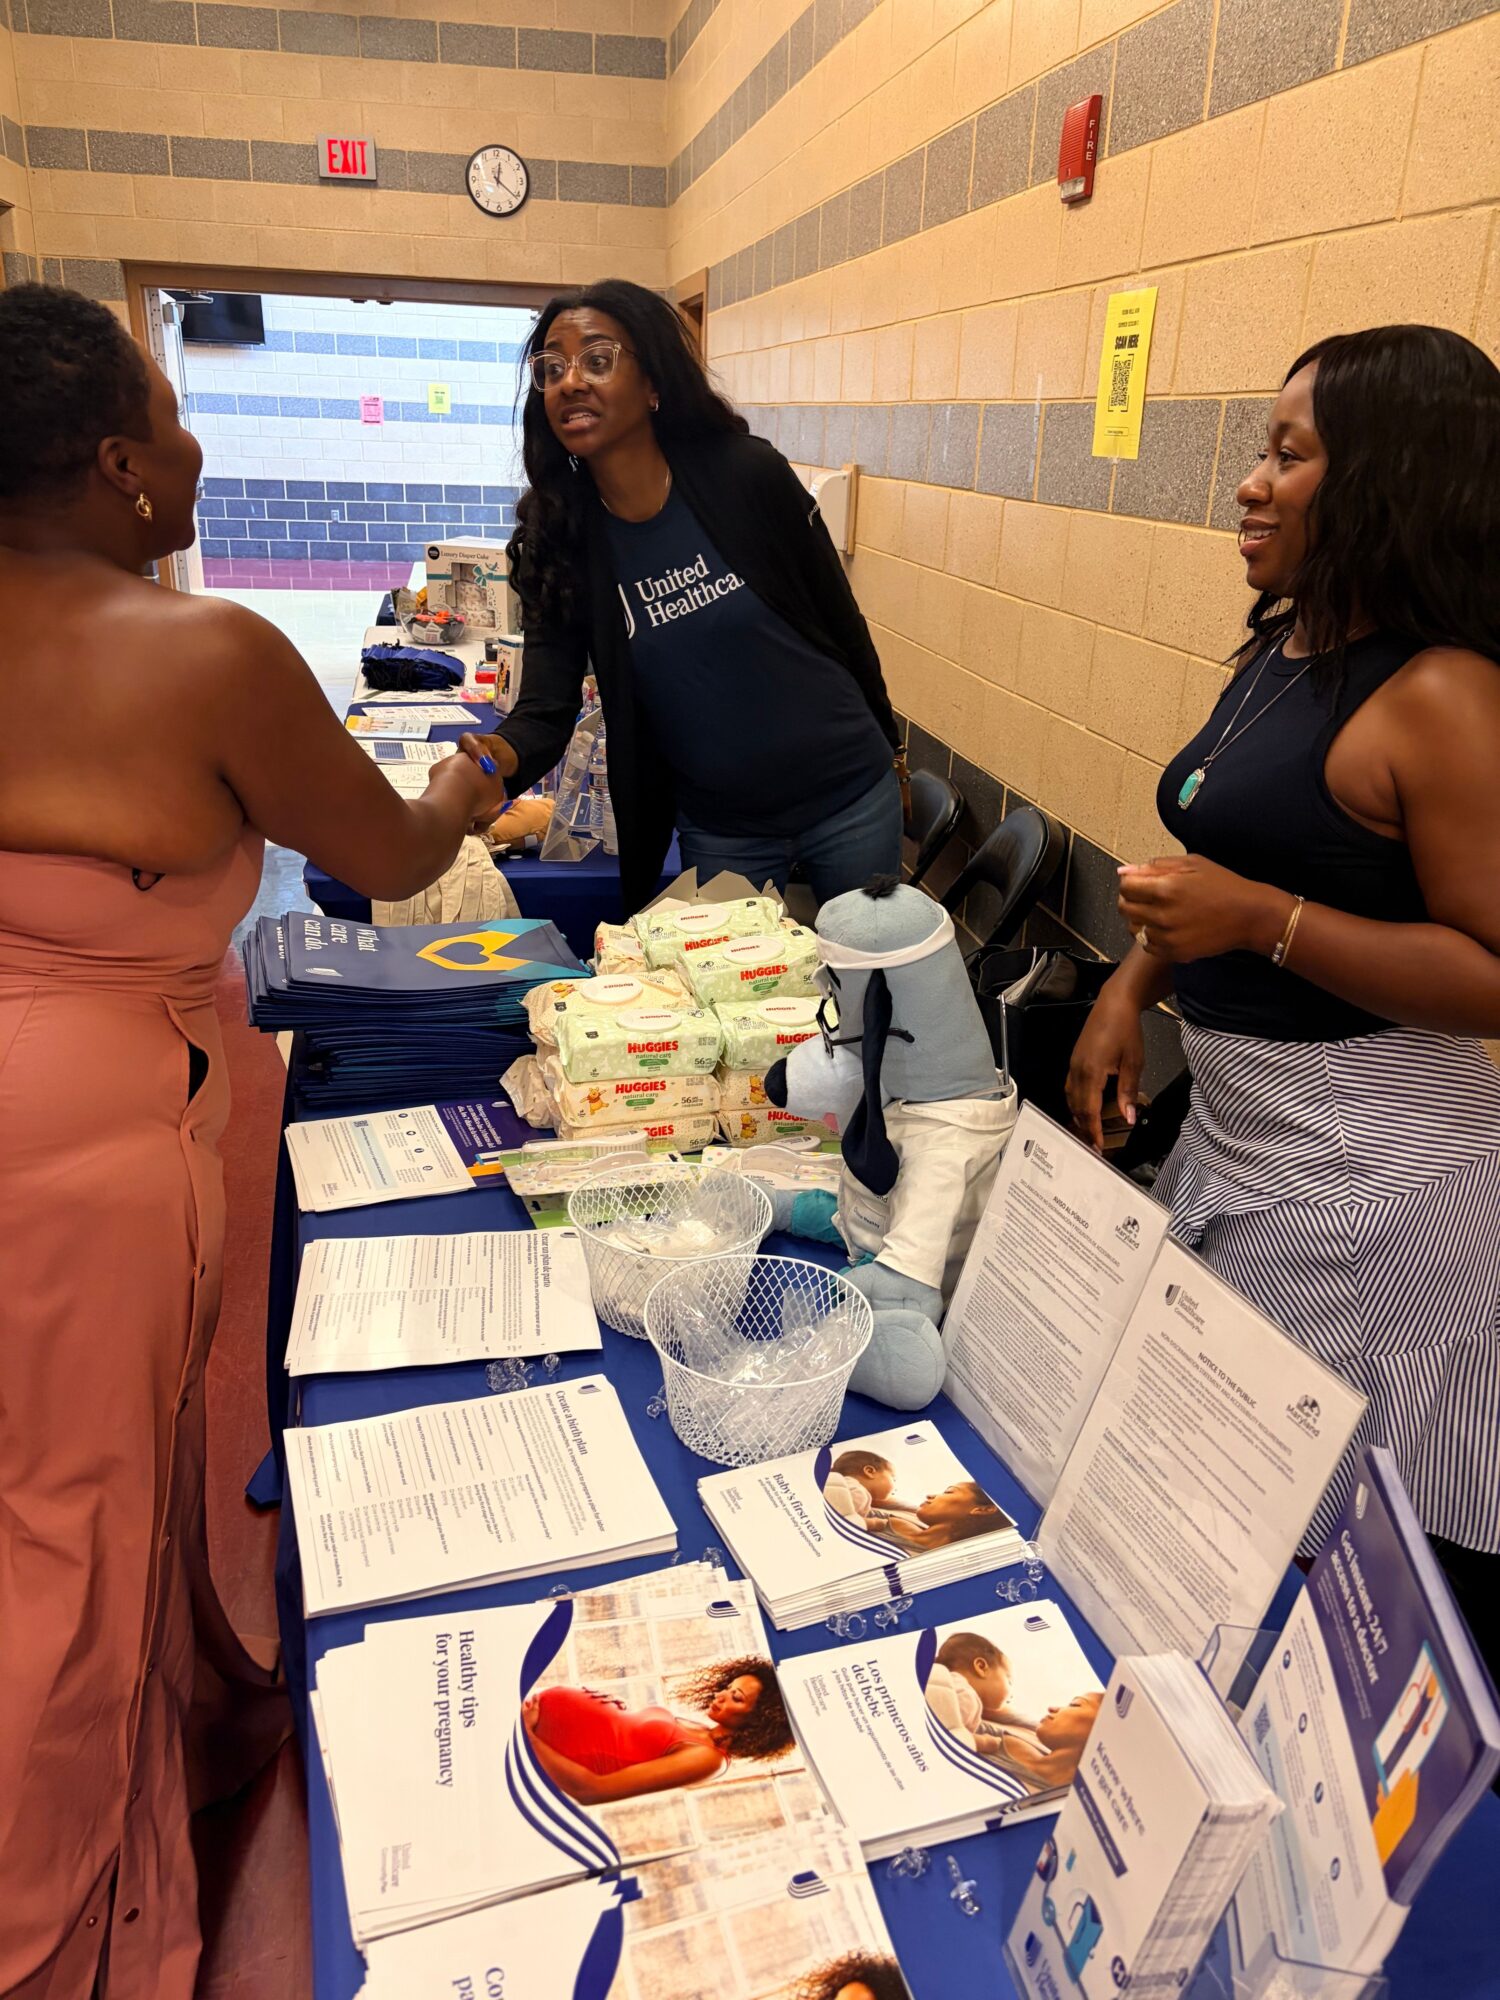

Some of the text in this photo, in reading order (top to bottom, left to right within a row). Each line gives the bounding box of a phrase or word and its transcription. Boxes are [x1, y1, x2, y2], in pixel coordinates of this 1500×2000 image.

[1086, 120, 1095, 160] FIRE
[327, 139, 367, 175] EXIT
[476, 190, 480, 198] 8
[1115, 334, 1139, 350] SCAN HERE
[458, 552, 476, 560] Diaper
[476, 552, 489, 560] Cake
[634, 553, 710, 602] United
[644, 572, 745, 627] Healthca
[304, 920, 328, 950] can do.
[330, 924, 348, 943] care
[356, 929, 381, 952] What
[740, 965, 788, 981] HUGGIES
[627, 1040, 678, 1053] HUGGIES
[615, 1081, 666, 1094] HUGGIES
[1053, 1195, 1066, 1209] AVISO
[1064, 1205, 1071, 1214] AL
[541, 1232, 549, 1245] Crear
[1115, 1225, 1140, 1249] Maryland
[540, 1253, 550, 1265] plan
[541, 1272, 551, 1287] parto
[1180, 1289, 1199, 1310] United
[1177, 1297, 1206, 1326] Healthcare
[1197, 1351, 1257, 1409] NOTICE TO THE PUBLIC
[554, 1390, 572, 1413] Create
[565, 1418, 583, 1437] birth
[1286, 1404, 1320, 1438] Maryland
[571, 1437, 590, 1455] plan
[772, 1472, 824, 1542] Baby's first years
[1341, 1529, 1355, 1561] Get
[1369, 1615, 1388, 1655] 24/7
[1331, 1550, 1379, 1686] access to a doctor
[457, 1630, 479, 1727] Healthy tips
[834, 1674, 843, 1683] los
[845, 1682, 857, 1697] para
[838, 1683, 850, 1700] hitos
[850, 1663, 884, 1718] del bebé
[432, 1632, 453, 1787] for your pregnancy
[845, 1700, 854, 1709] de
[853, 1697, 865, 1714] hacer
[865, 1659, 930, 1772] Los primeros años
[861, 1715, 869, 1724] un
[864, 1724, 888, 1760] seguimiento
[1090, 1757, 1129, 1833] to get care
[1097, 1741, 1146, 1837] Know where
[486, 1967, 504, 2000] Co
